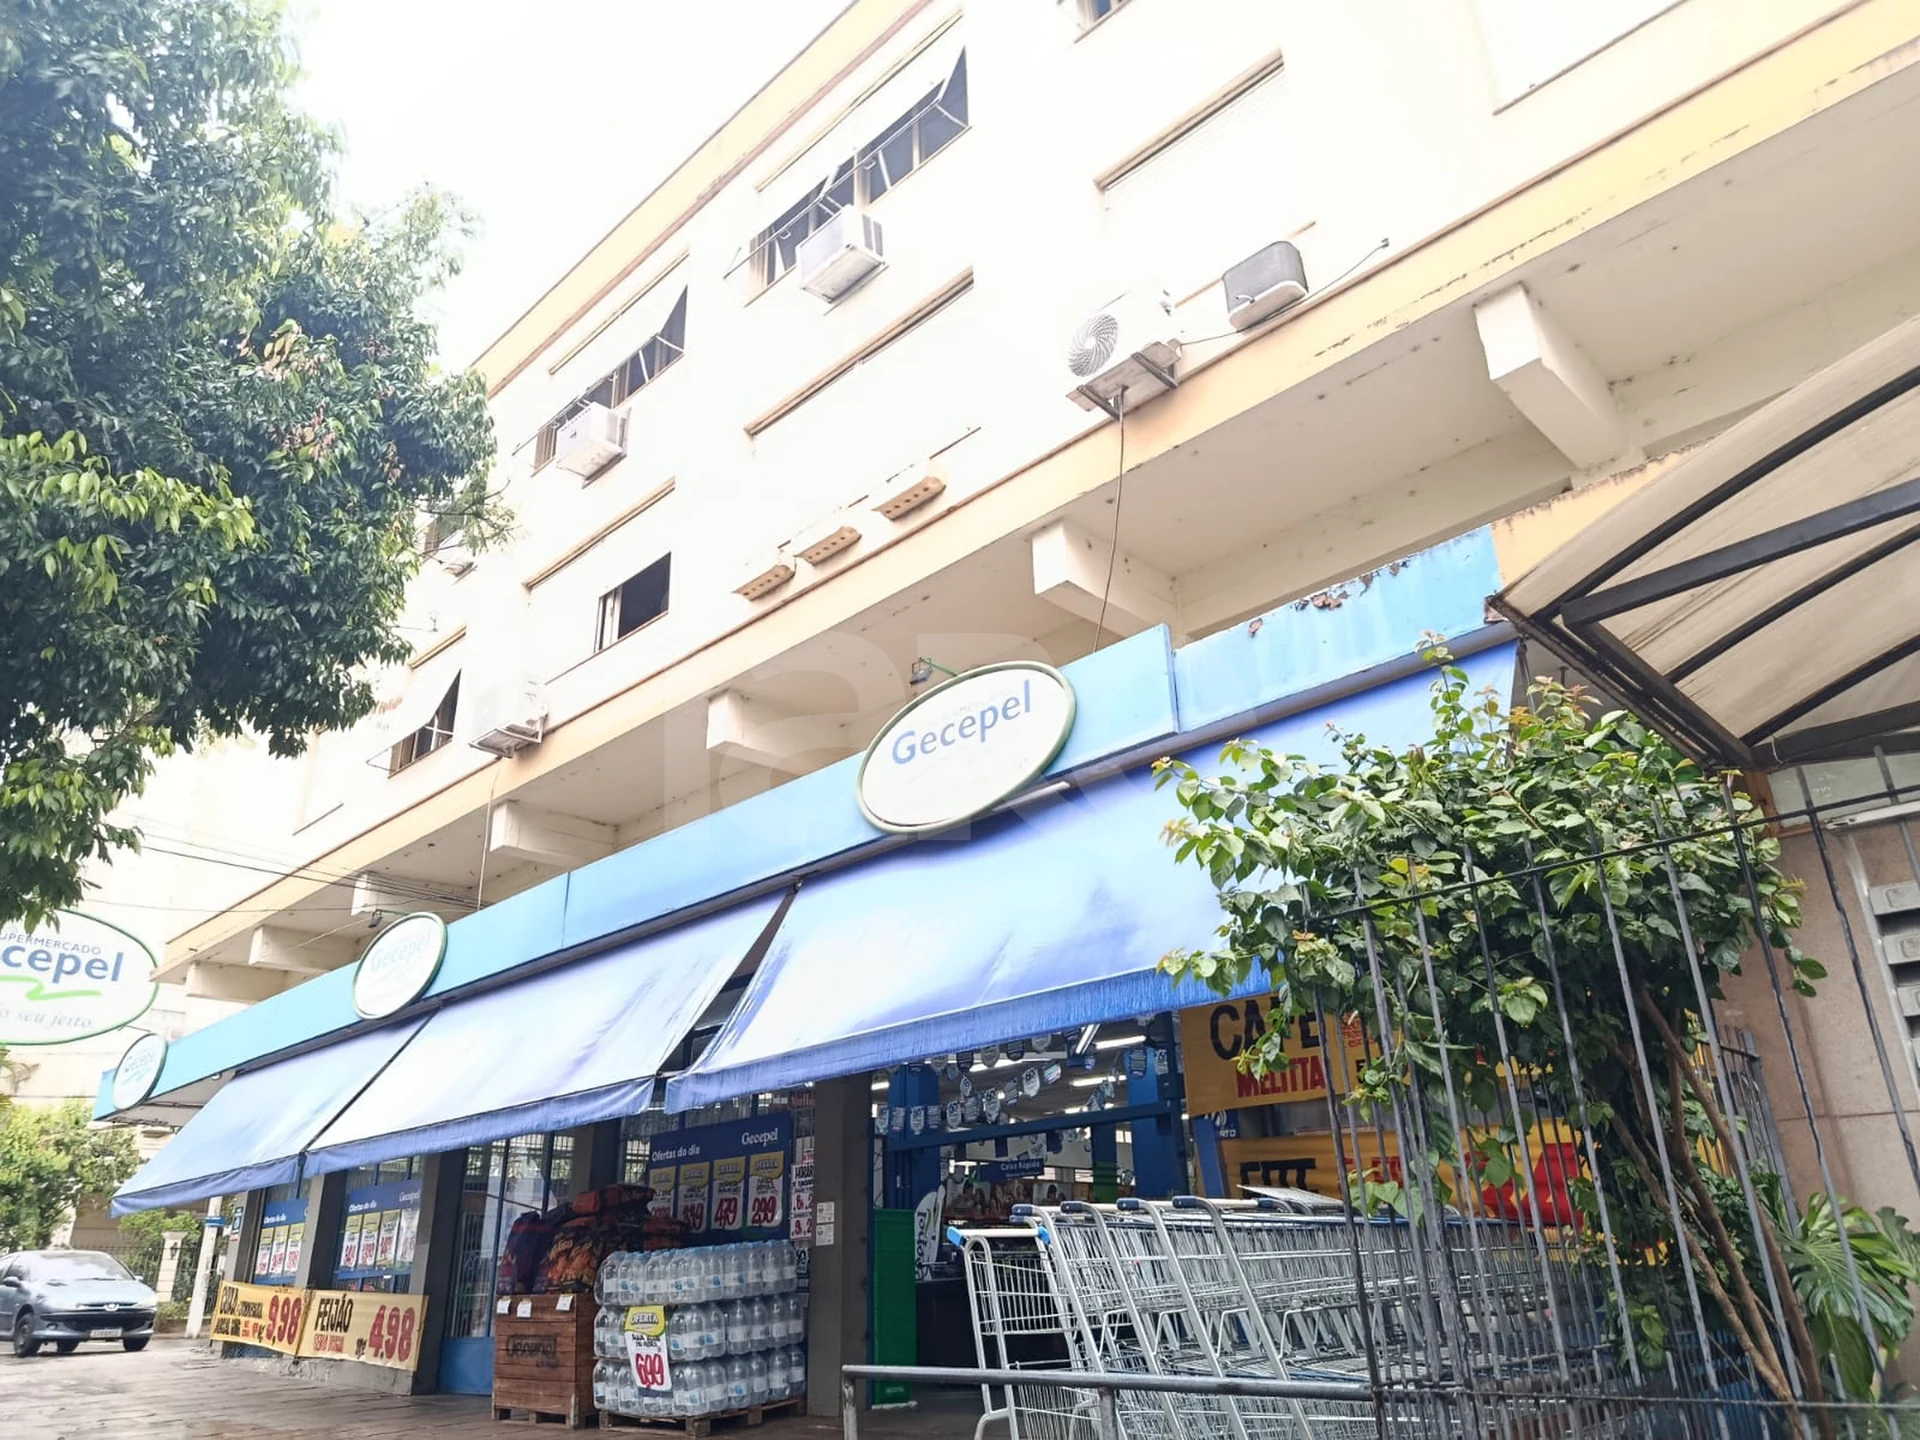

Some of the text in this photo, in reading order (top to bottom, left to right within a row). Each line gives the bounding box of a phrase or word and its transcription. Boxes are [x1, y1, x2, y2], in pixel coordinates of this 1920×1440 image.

[891, 679, 1032, 766] Gecepel
[2, 943, 125, 985] cepel
[1236, 1055, 1326, 1099] MELITTA
[742, 1127, 778, 1148] Gecepel
[631, 1312, 659, 1326] OFERTA
